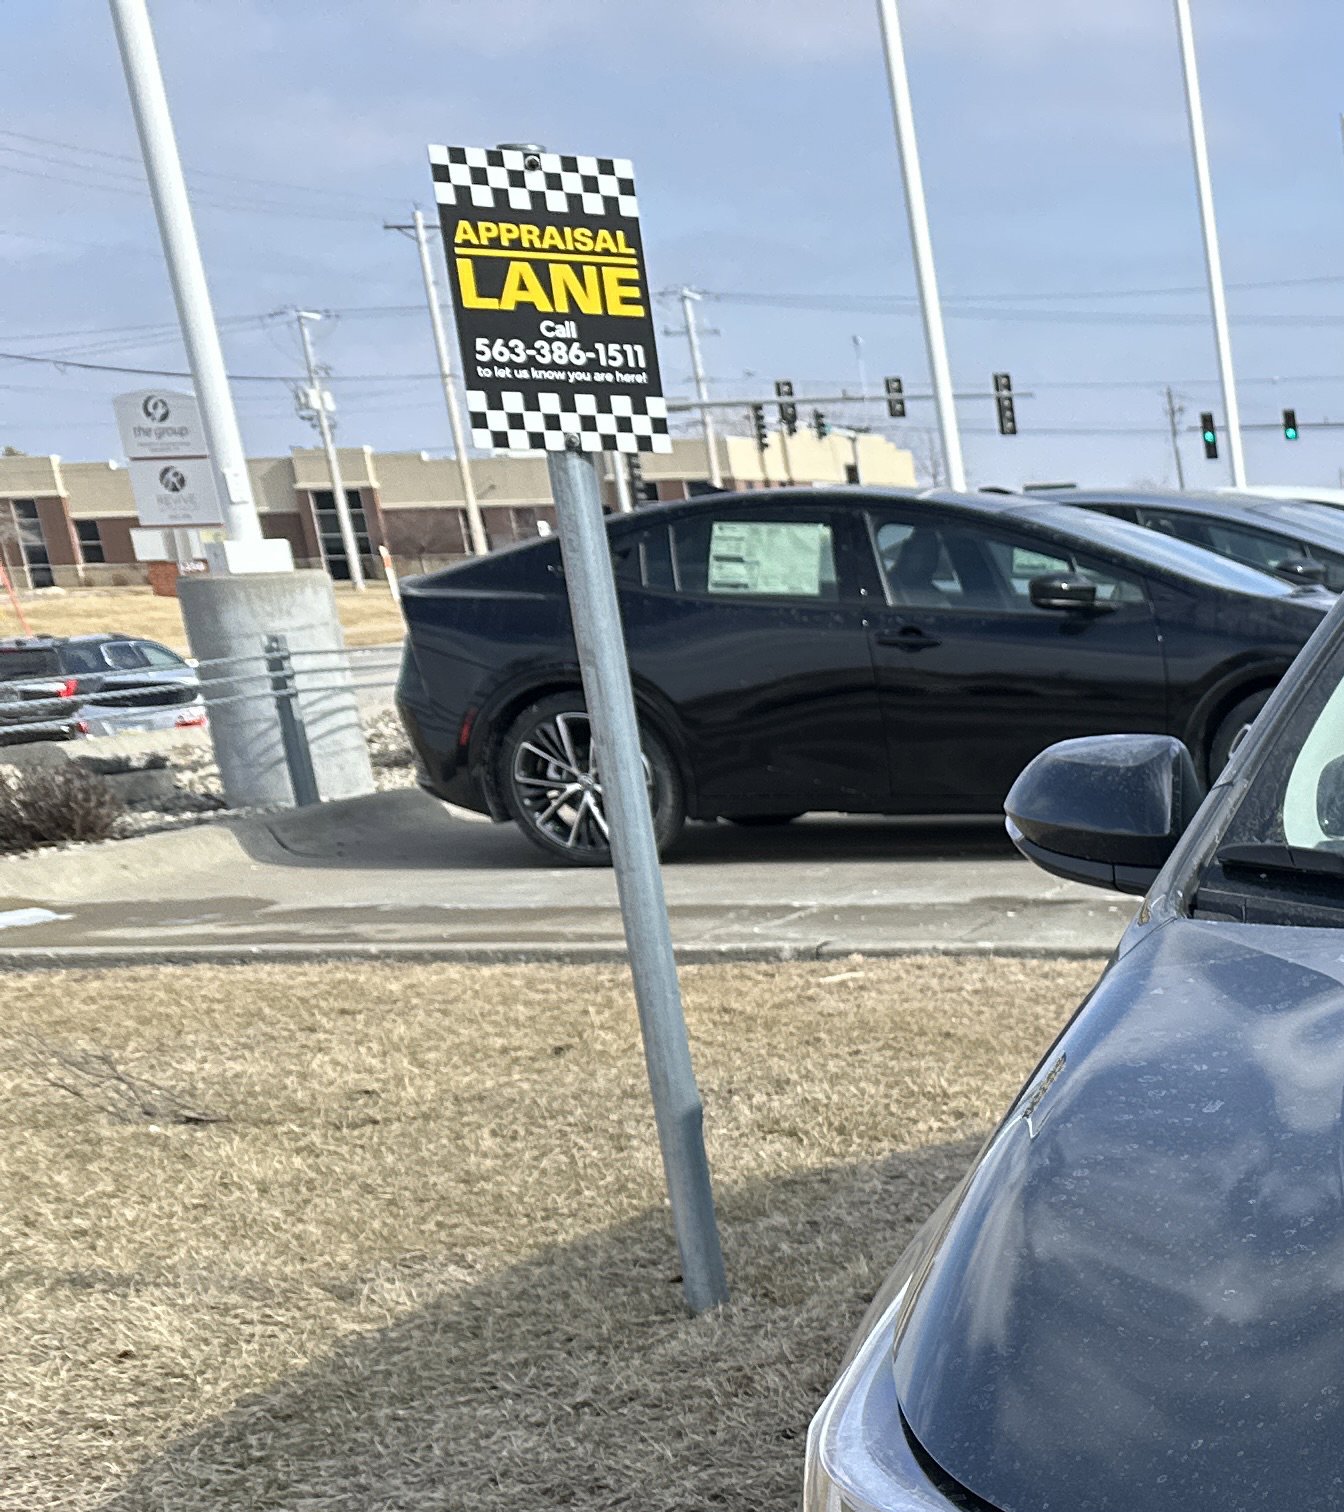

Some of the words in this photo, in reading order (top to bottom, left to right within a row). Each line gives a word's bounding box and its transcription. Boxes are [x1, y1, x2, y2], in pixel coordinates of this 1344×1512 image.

[454, 219, 636, 254] APPRAISAL
[456, 258, 645, 317] LANE
[539, 320, 579, 339] Call
[475, 337, 647, 369] 563-386-1511
[477, 366, 493, 378] to
[494, 366, 512, 379] let
[514, 368, 530, 380] us
[531, 367, 566, 381] know
[567, 370, 592, 384] you
[593, 371, 615, 382] are
[615, 371, 648, 384] here!
[132, 426, 152, 438] the
[154, 426, 189, 440] group
